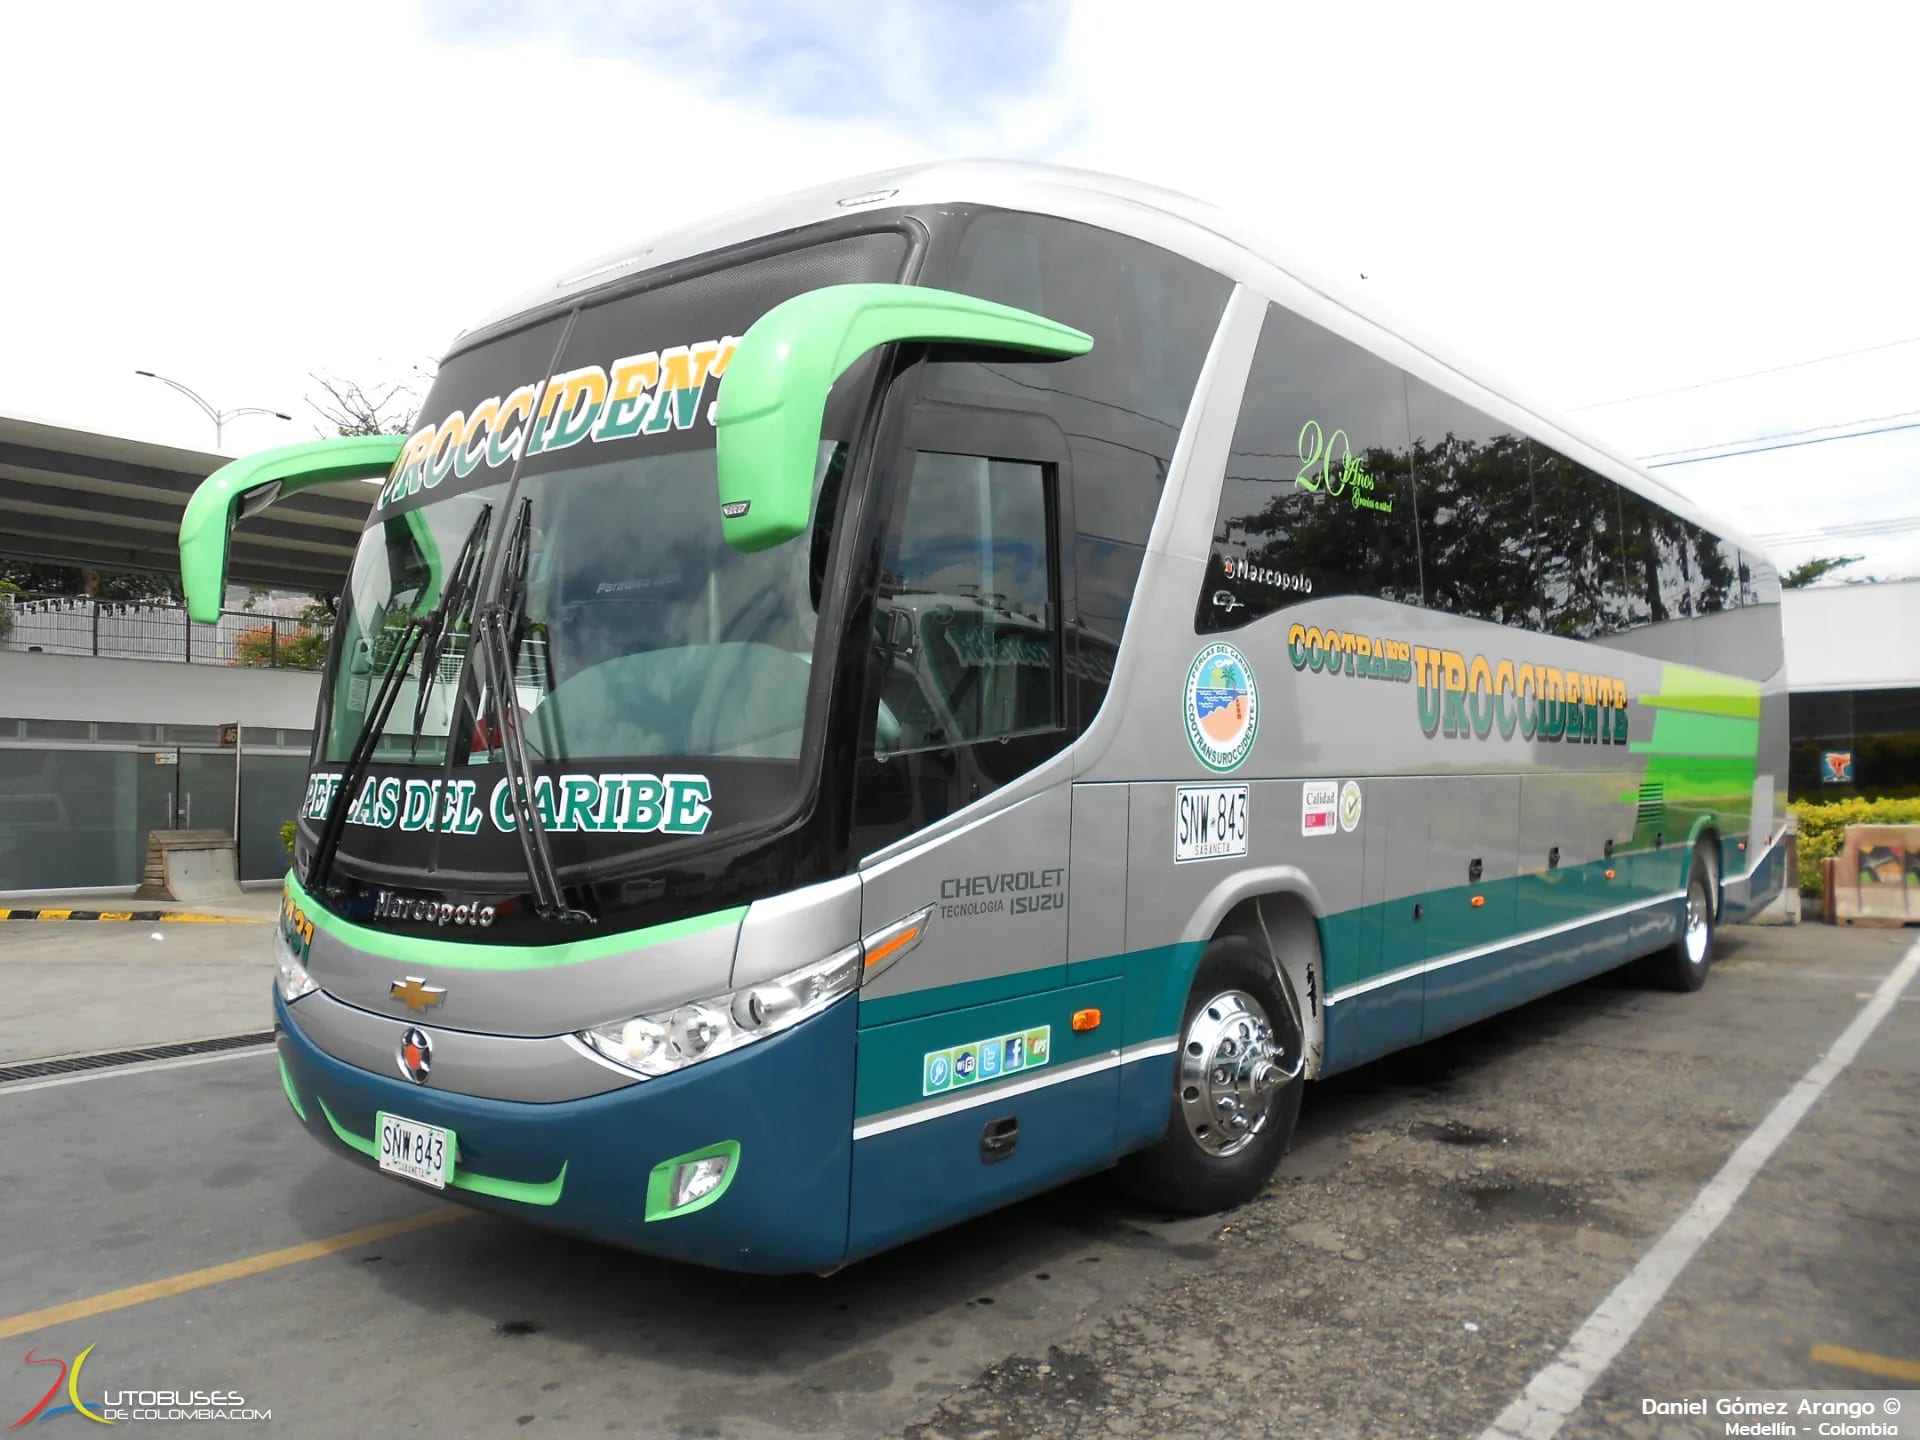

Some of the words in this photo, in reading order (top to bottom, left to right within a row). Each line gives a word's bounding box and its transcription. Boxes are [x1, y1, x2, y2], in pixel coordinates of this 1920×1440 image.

[1295, 420, 1350, 496] 20
[1237, 558, 1312, 594] Marcopolo
[1191, 646, 1216, 679] PERLAS
[1216, 645, 1230, 655] DEL
[1230, 649, 1252, 683] CARIBE
[1288, 623, 1411, 682] COOTRANS
[1414, 645, 1628, 745] UROCCIDENTE
[302, 773, 401, 829] PEAS
[400, 779, 483, 836] DEL
[490, 773, 712, 835] CARIBE
[1306, 791, 1335, 806] Calidad
[941, 869, 1065, 899] CHEVROLET
[374, 889, 497, 928] Marcopolo
[940, 900, 1004, 919] TECNOLOGIA
[1010, 892, 1064, 915] ISUZU
[382, 1126, 411, 1161] SNW
[414, 1135, 443, 1171] 843
